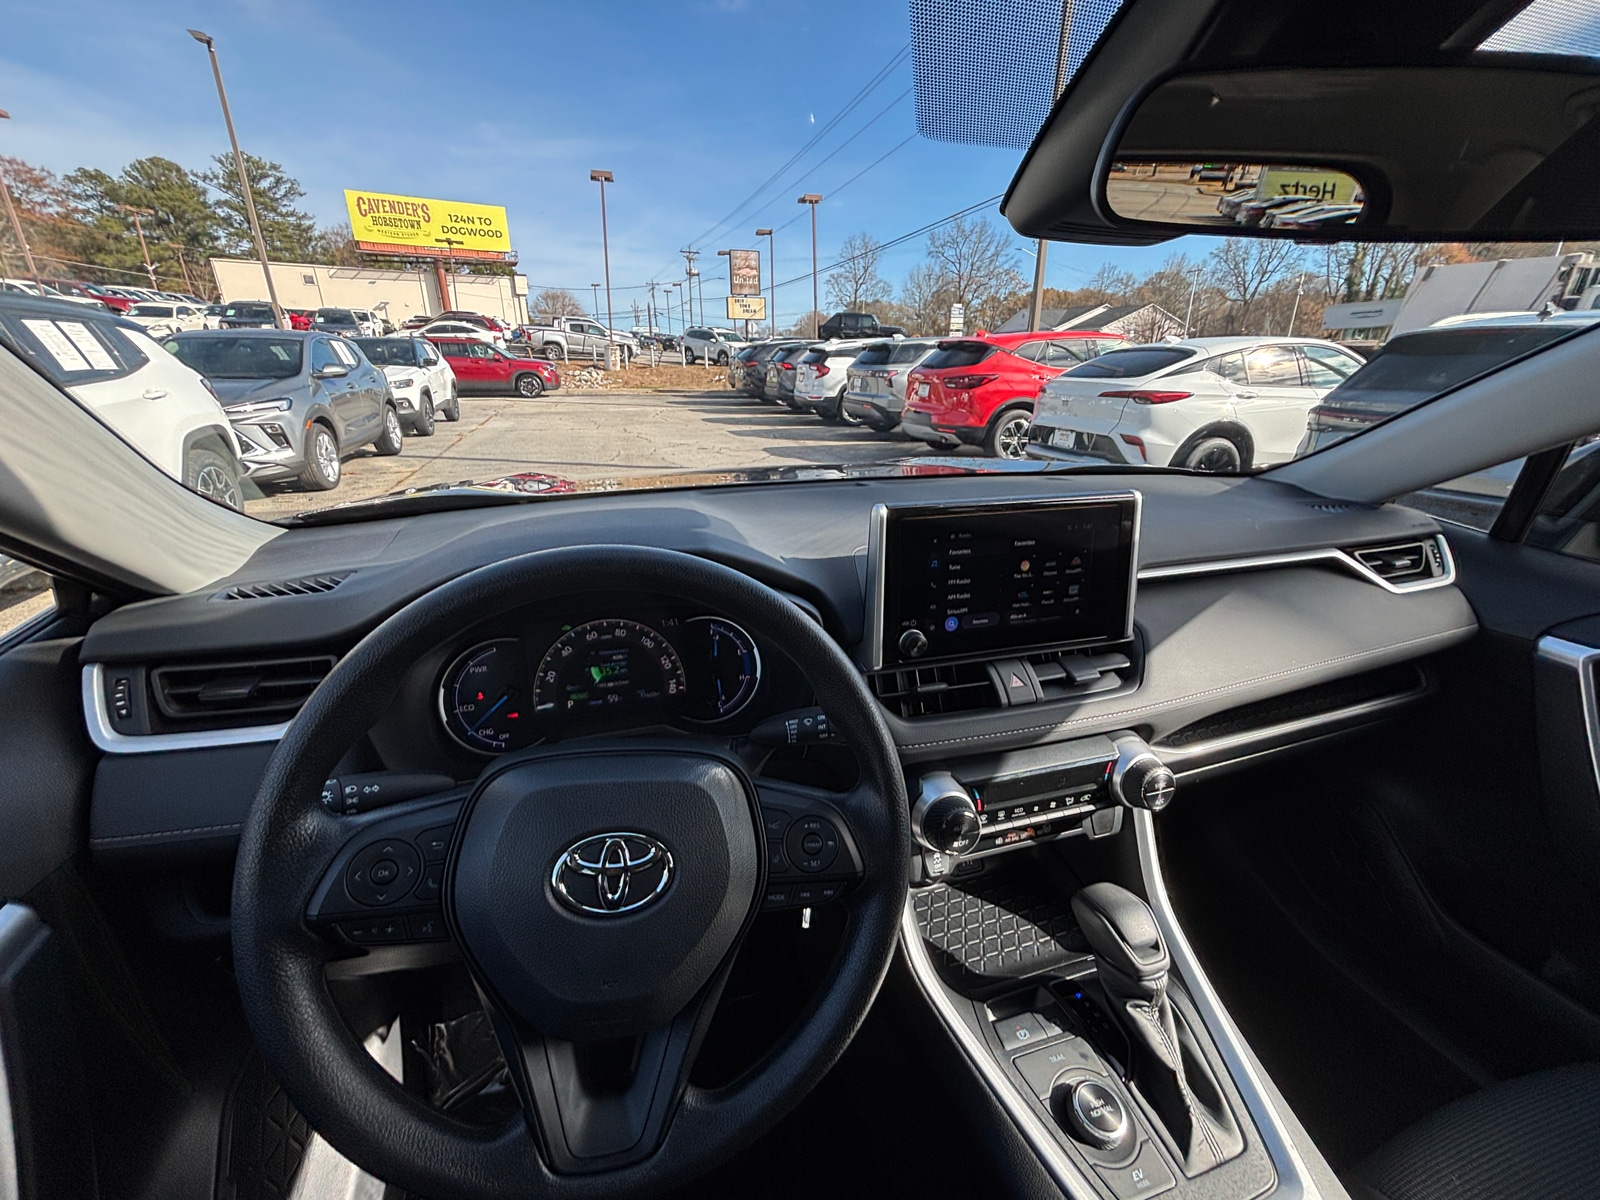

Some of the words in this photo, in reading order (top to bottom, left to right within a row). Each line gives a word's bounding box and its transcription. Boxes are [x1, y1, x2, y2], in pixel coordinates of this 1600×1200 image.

[356, 196, 432, 224] CAVENDER'S
[371, 216, 422, 230] HORSETOWN
[448, 214, 475, 225] 124N
[478, 216, 492, 226] TO
[441, 226, 503, 238] DOGWOOD
[734, 274, 758, 284] United
[661, 618, 679, 627] 1:41
[586, 631, 598, 641] 60
[614, 628, 627, 637] 80
[640, 636, 655, 649] 100
[561, 646, 572, 657] 40
[660, 654, 672, 670] 120
[470, 665, 488, 674] PWR
[602, 666, 620, 675] 35.2
[546, 670, 556, 683] 20
[668, 678, 677, 694] 140
[460, 704, 474, 712] ECO
[568, 700, 574, 709] P
[478, 728, 494, 736] CHG
[378, 867, 390, 877] OK
[1132, 1168, 1143, 1180] EV
